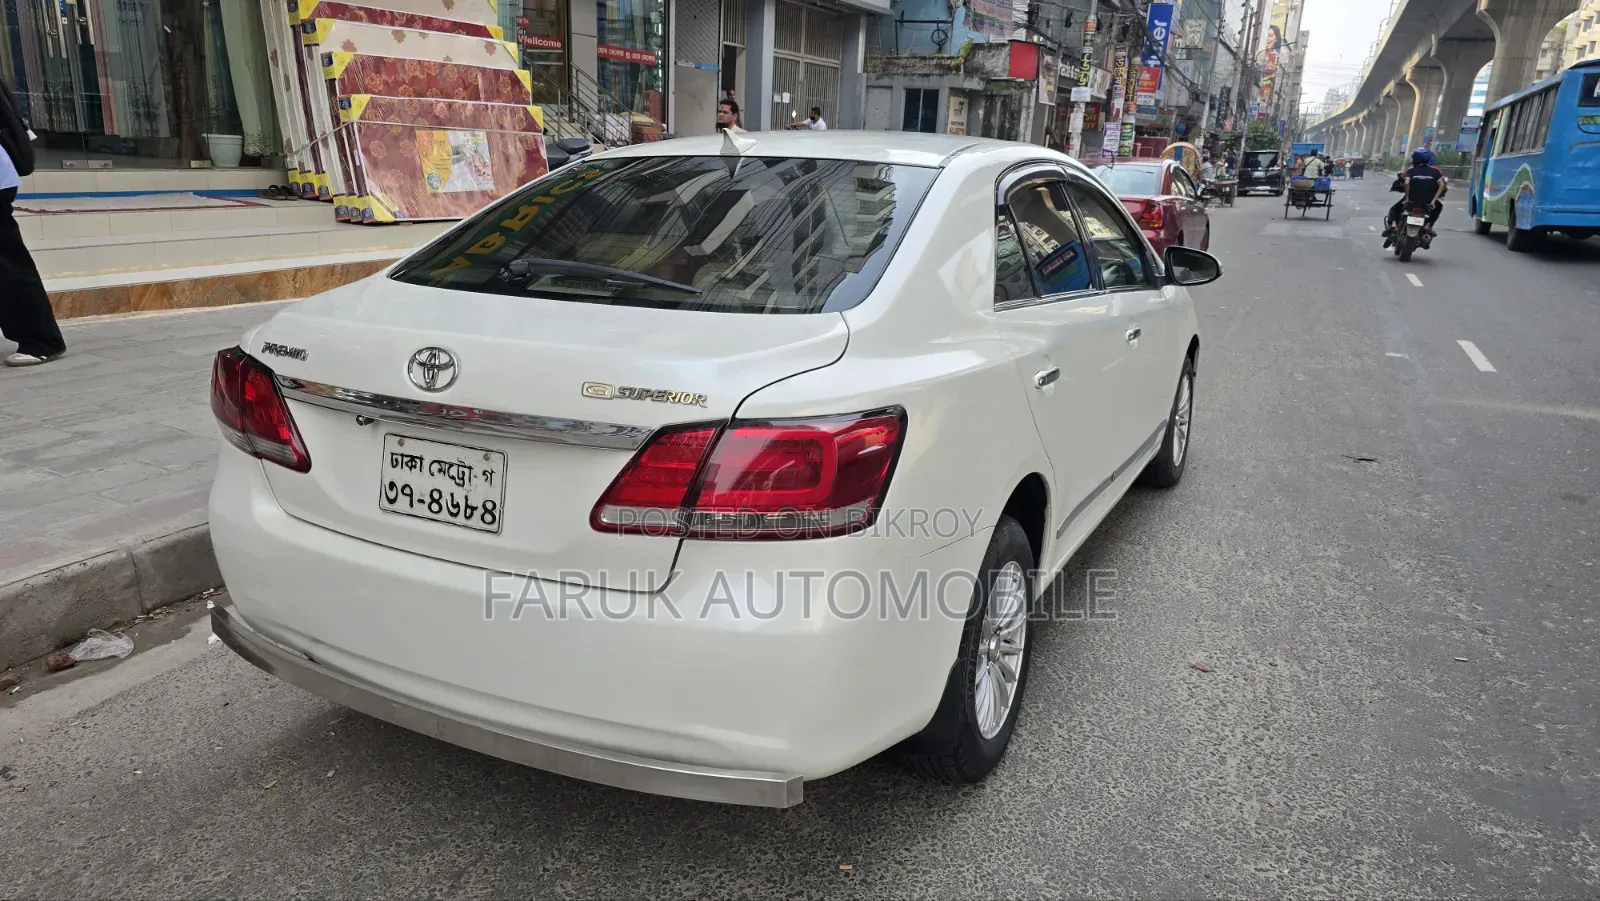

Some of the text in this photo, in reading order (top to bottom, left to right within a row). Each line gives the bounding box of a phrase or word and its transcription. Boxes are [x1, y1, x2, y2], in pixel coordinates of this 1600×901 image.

[517, 34, 562, 48] Wellcome
[615, 385, 708, 408] SUPERIOR
[389, 451, 425, 473] ঢাকা
[384, 480, 498, 525] ৩৭-৪৬৮৪
